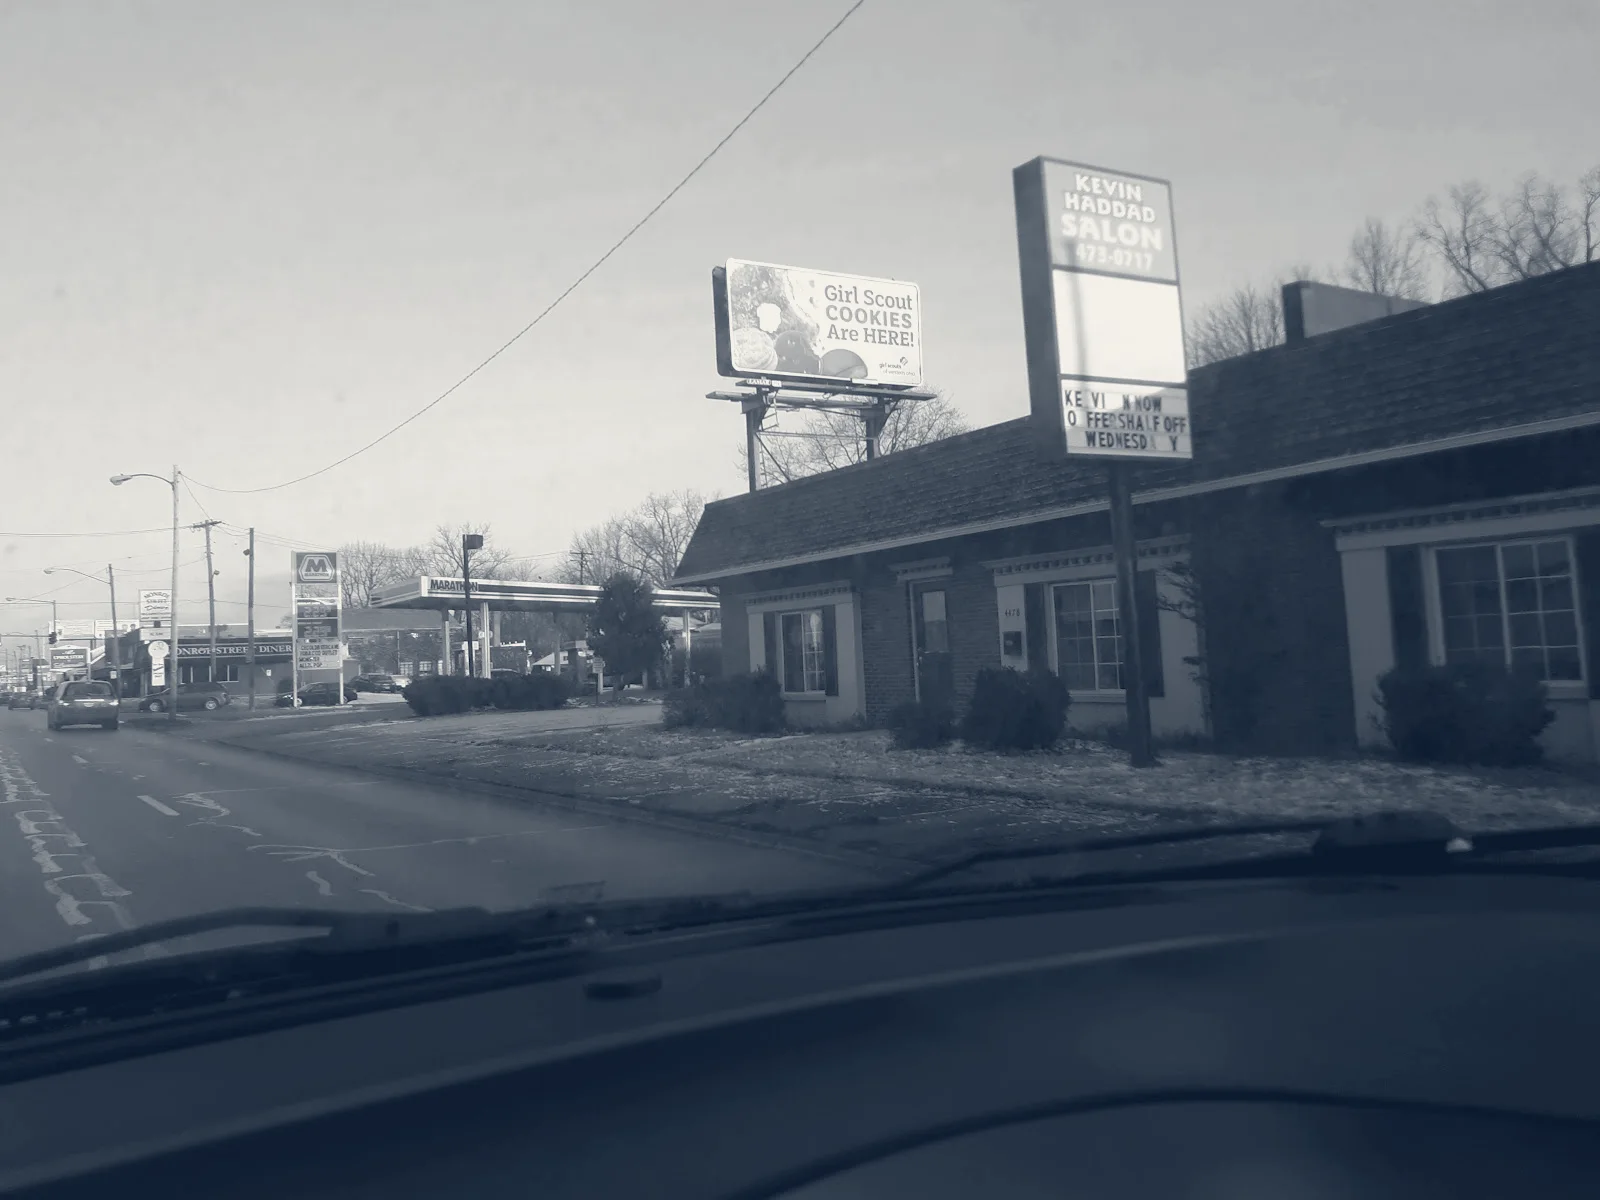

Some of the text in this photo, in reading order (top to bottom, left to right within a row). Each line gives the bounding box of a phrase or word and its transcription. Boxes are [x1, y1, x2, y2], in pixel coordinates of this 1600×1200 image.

[1075, 173, 1142, 202] KEVIN
[1064, 191, 1156, 223] HADDAD
[1061, 212, 1163, 250] SALON
[824, 284, 913, 311] Girl Scout
[825, 304, 912, 329] COOKIES
[827, 323, 914, 347] Are HERE!
[1163, 415, 1187, 433] OFF
[430, 579, 478, 592] MARATHN
[216, 646, 256, 654] STREE
[259, 644, 292, 653] DINER
